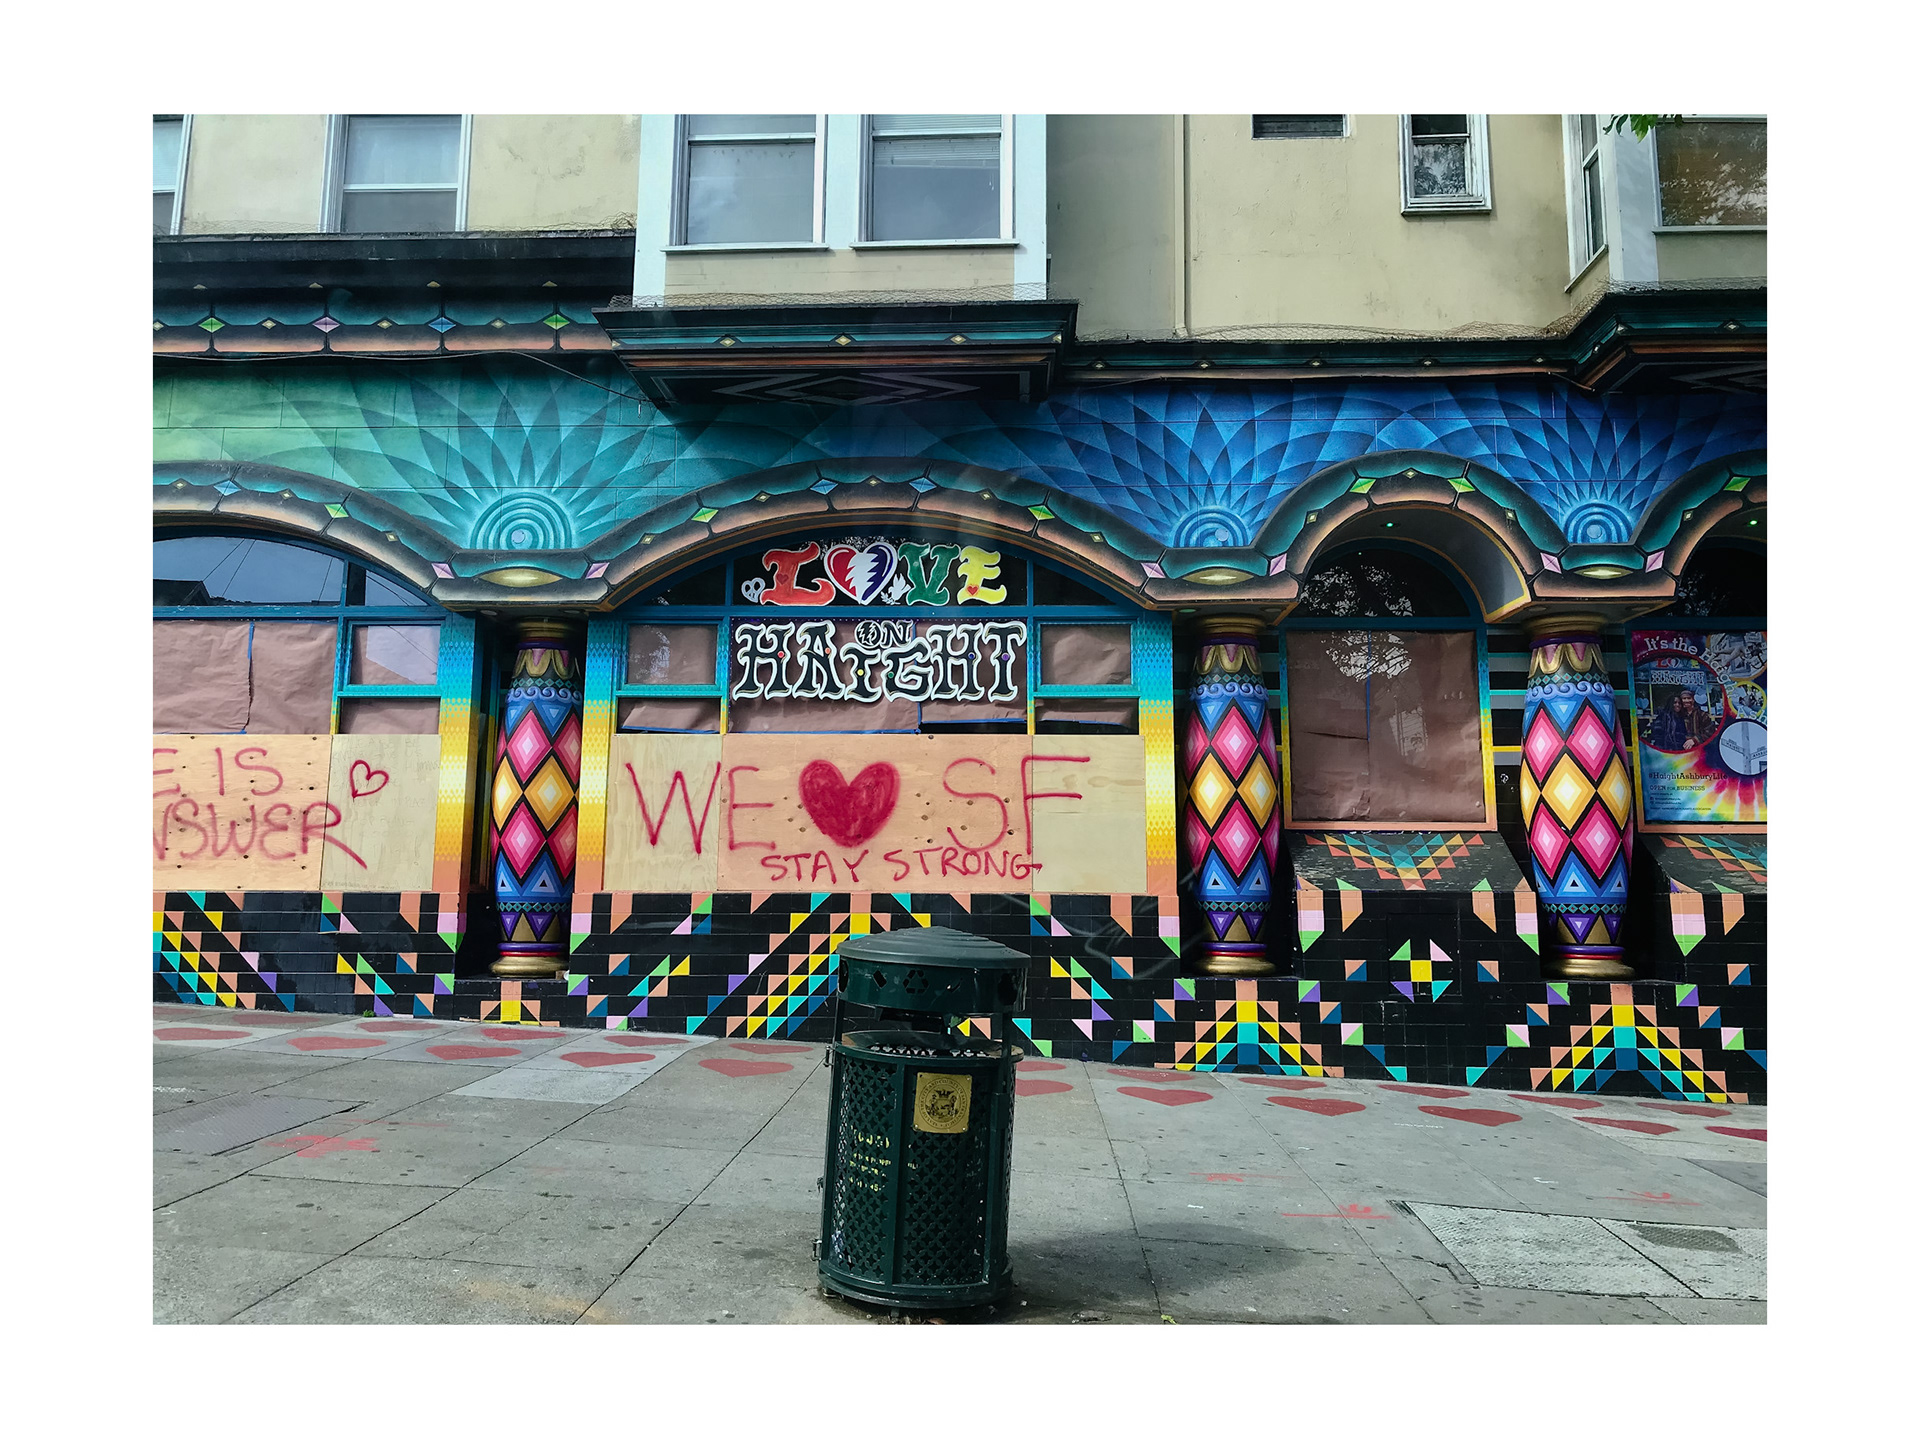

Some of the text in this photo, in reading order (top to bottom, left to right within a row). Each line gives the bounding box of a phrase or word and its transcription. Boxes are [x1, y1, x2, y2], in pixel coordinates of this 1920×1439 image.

[732, 619, 1027, 702] HAIGHT
[1644, 636, 1669, 652] It's
[1672, 637, 1698, 655] the
[215, 747, 283, 796] IS
[625, 756, 1091, 856] WE SF
[761, 846, 1043, 884] STAY STRONG
